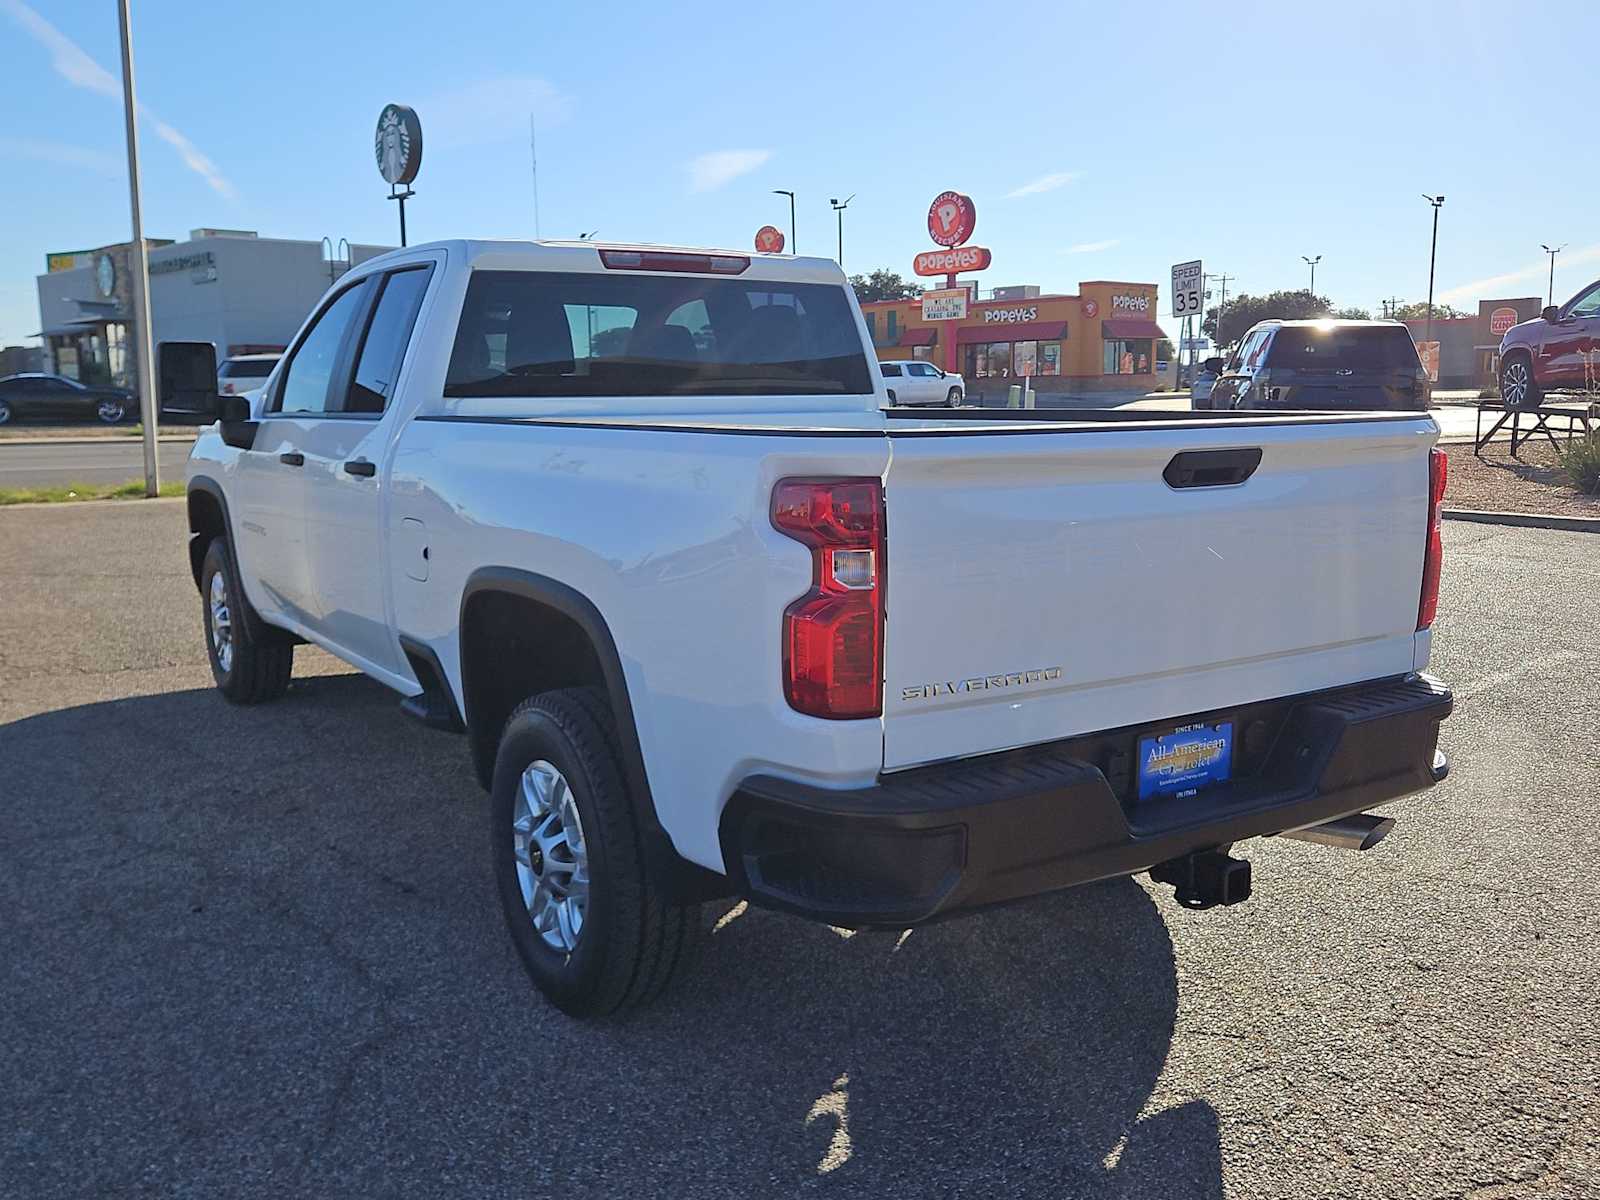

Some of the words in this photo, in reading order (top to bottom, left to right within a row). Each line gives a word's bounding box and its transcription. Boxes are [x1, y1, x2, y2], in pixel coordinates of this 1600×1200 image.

[938, 203, 957, 232] P
[1173, 266, 1200, 279] SPEED
[1176, 279, 1196, 291] LIMIT
[1176, 291, 1199, 312] 35
[902, 666, 1062, 700] SILVERADO
[1175, 725, 1191, 734] SINCE
[1147, 745, 1166, 762] All
[1170, 738, 1226, 757] American
